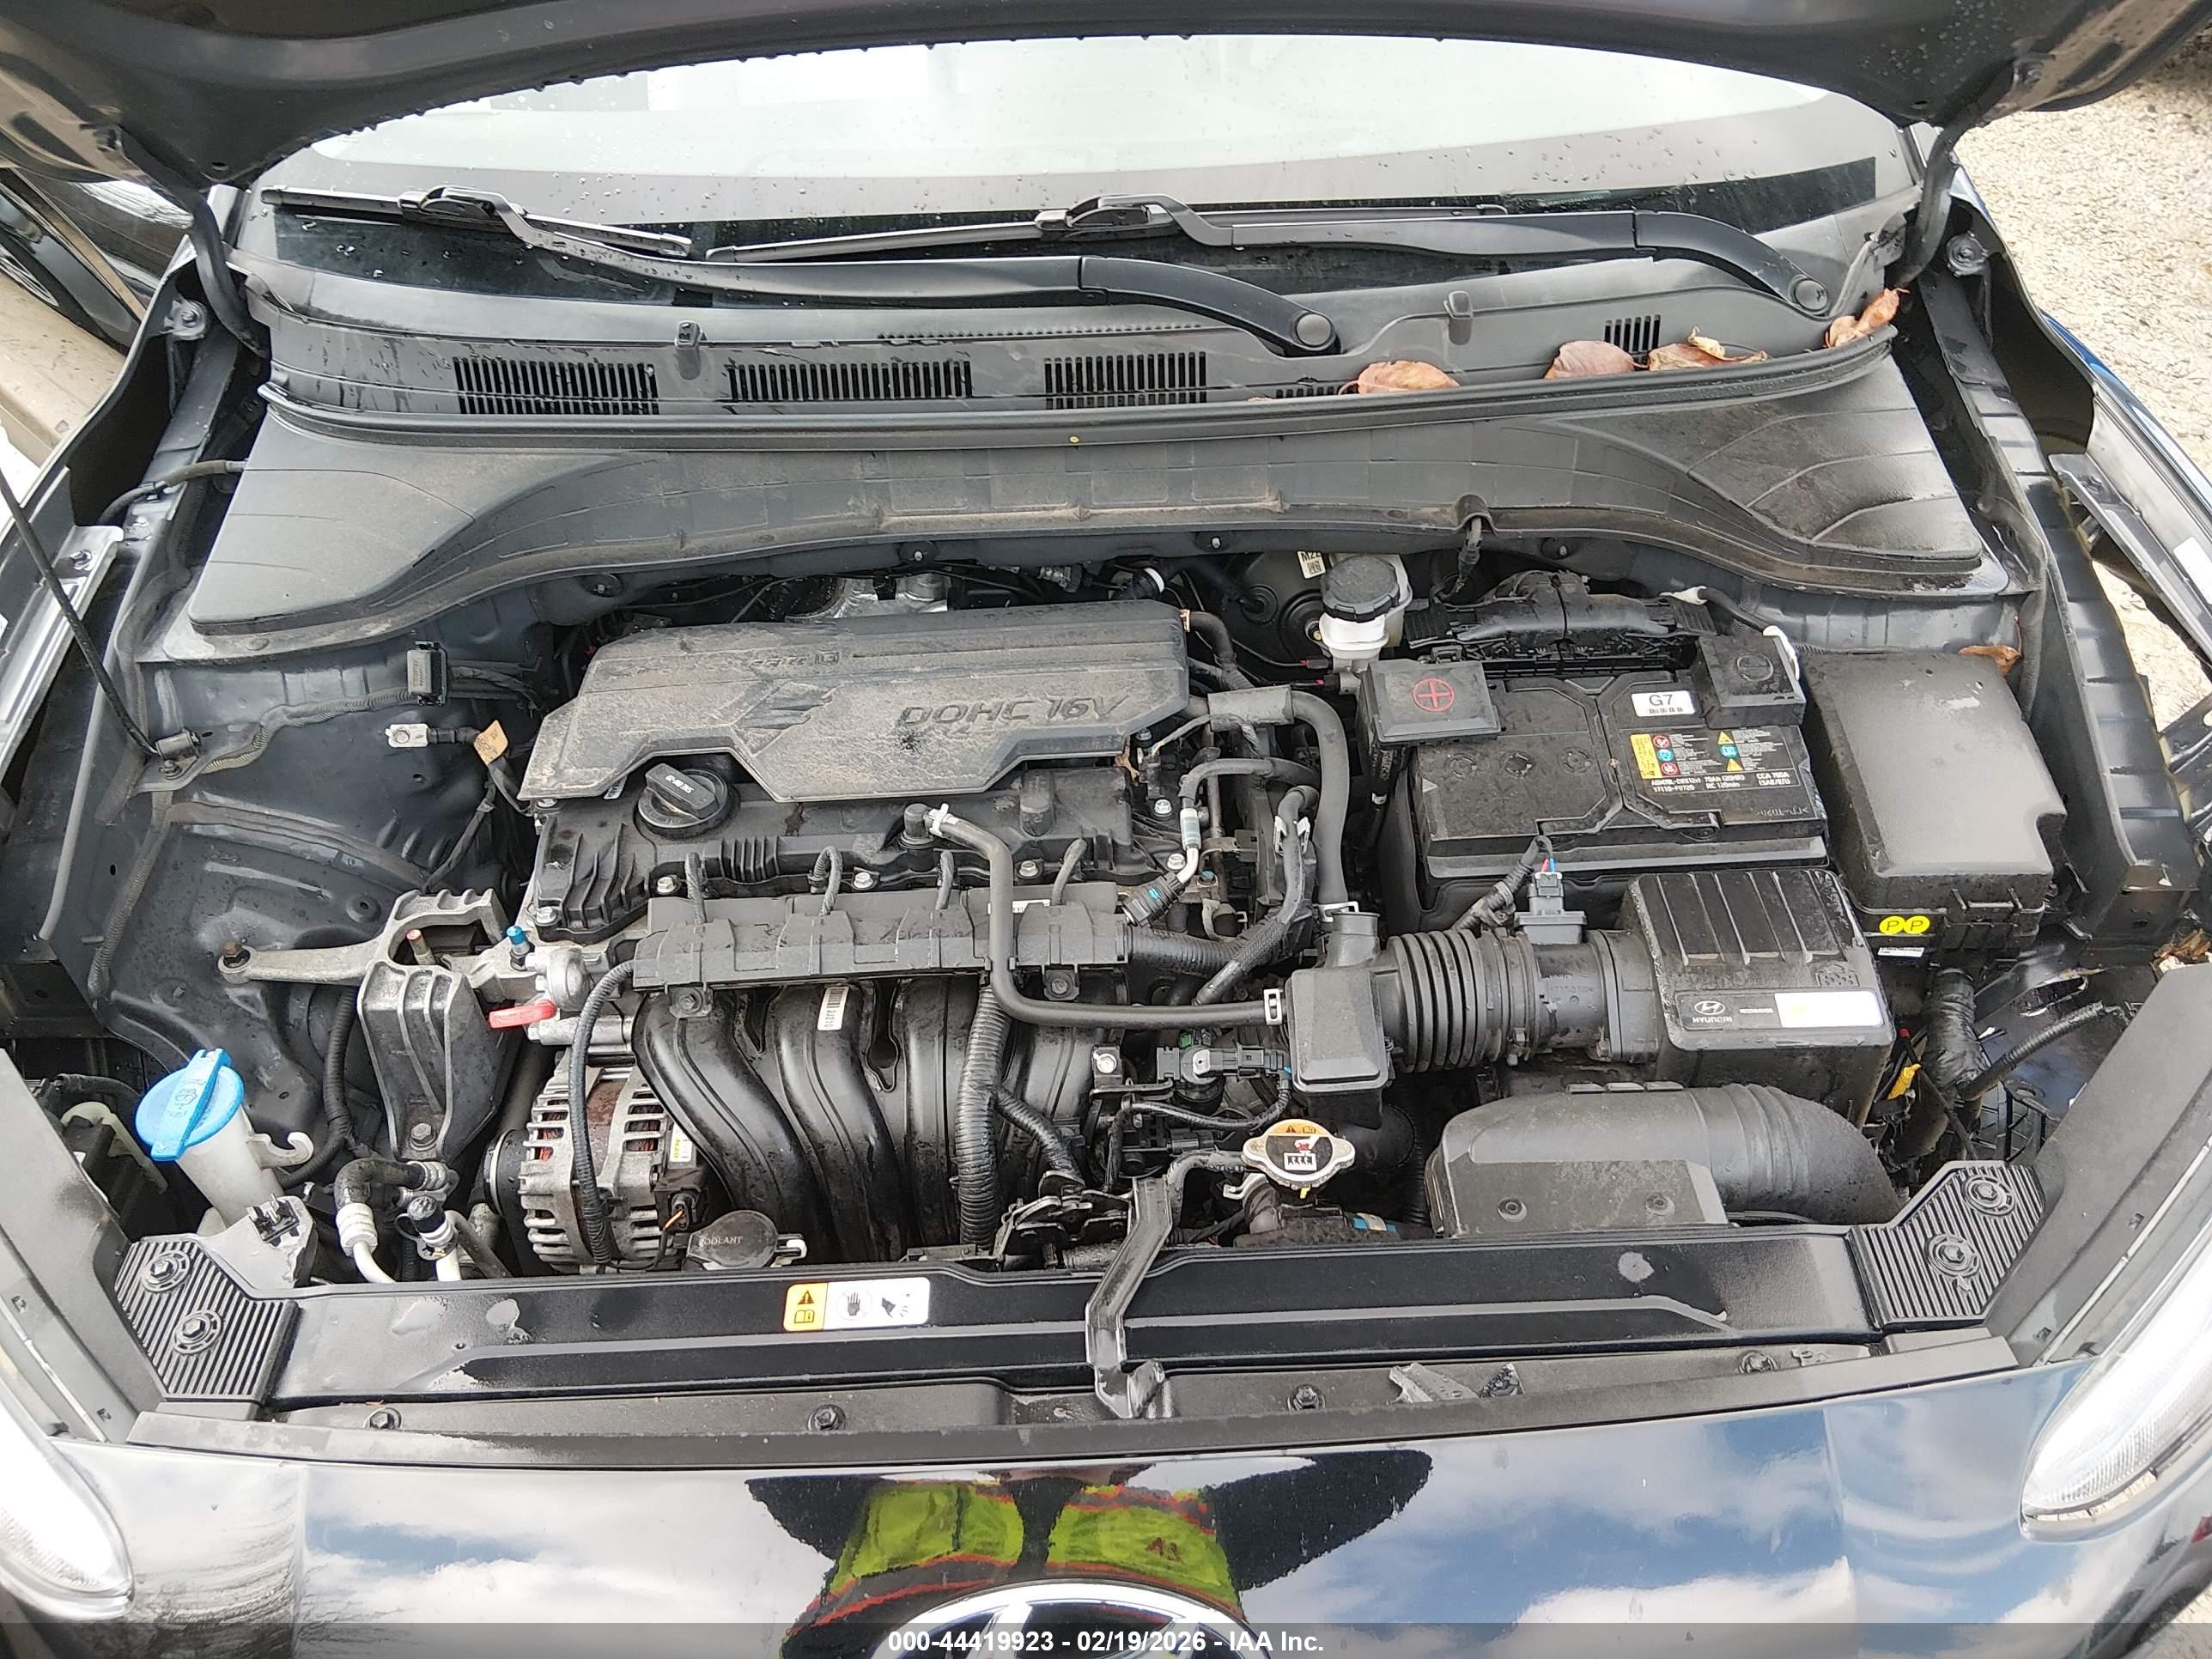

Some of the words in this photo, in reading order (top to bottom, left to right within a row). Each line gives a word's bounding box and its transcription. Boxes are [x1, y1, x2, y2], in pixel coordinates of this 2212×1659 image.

[1649, 694, 1673, 707] G7
[897, 697, 1036, 726] DOHC
[1044, 692, 1130, 721] 16V
[1886, 920, 1899, 932] P
[1910, 920, 1923, 932] P
